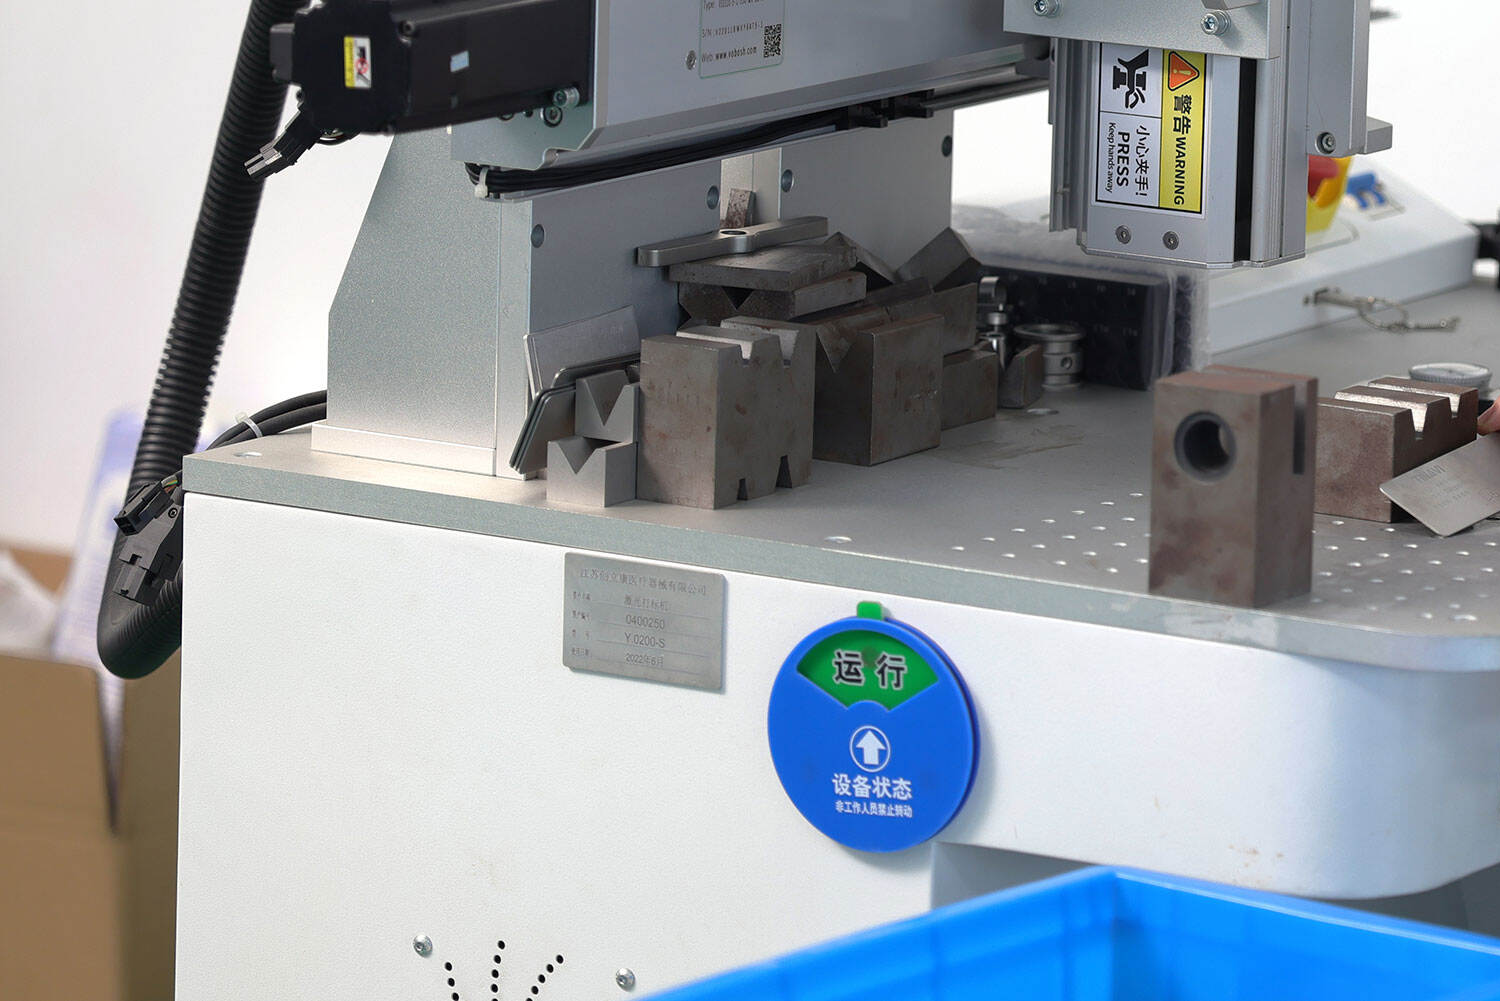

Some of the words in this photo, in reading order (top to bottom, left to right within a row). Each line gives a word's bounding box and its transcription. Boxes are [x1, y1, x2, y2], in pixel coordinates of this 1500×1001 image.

[1173, 94, 1192, 135] 警告
[1107, 122, 1116, 144] Keep
[1106, 144, 1115, 170] hands
[1116, 131, 1130, 187] PRESS
[1105, 170, 1113, 194] away
[1174, 137, 1186, 206] WARNING
[625, 614, 665, 631] 0400250
[624, 632, 666, 648] Y.0200-S
[832, 773, 912, 801] 设备状态
[835, 800, 913, 818] 非工作人员禁止转动
